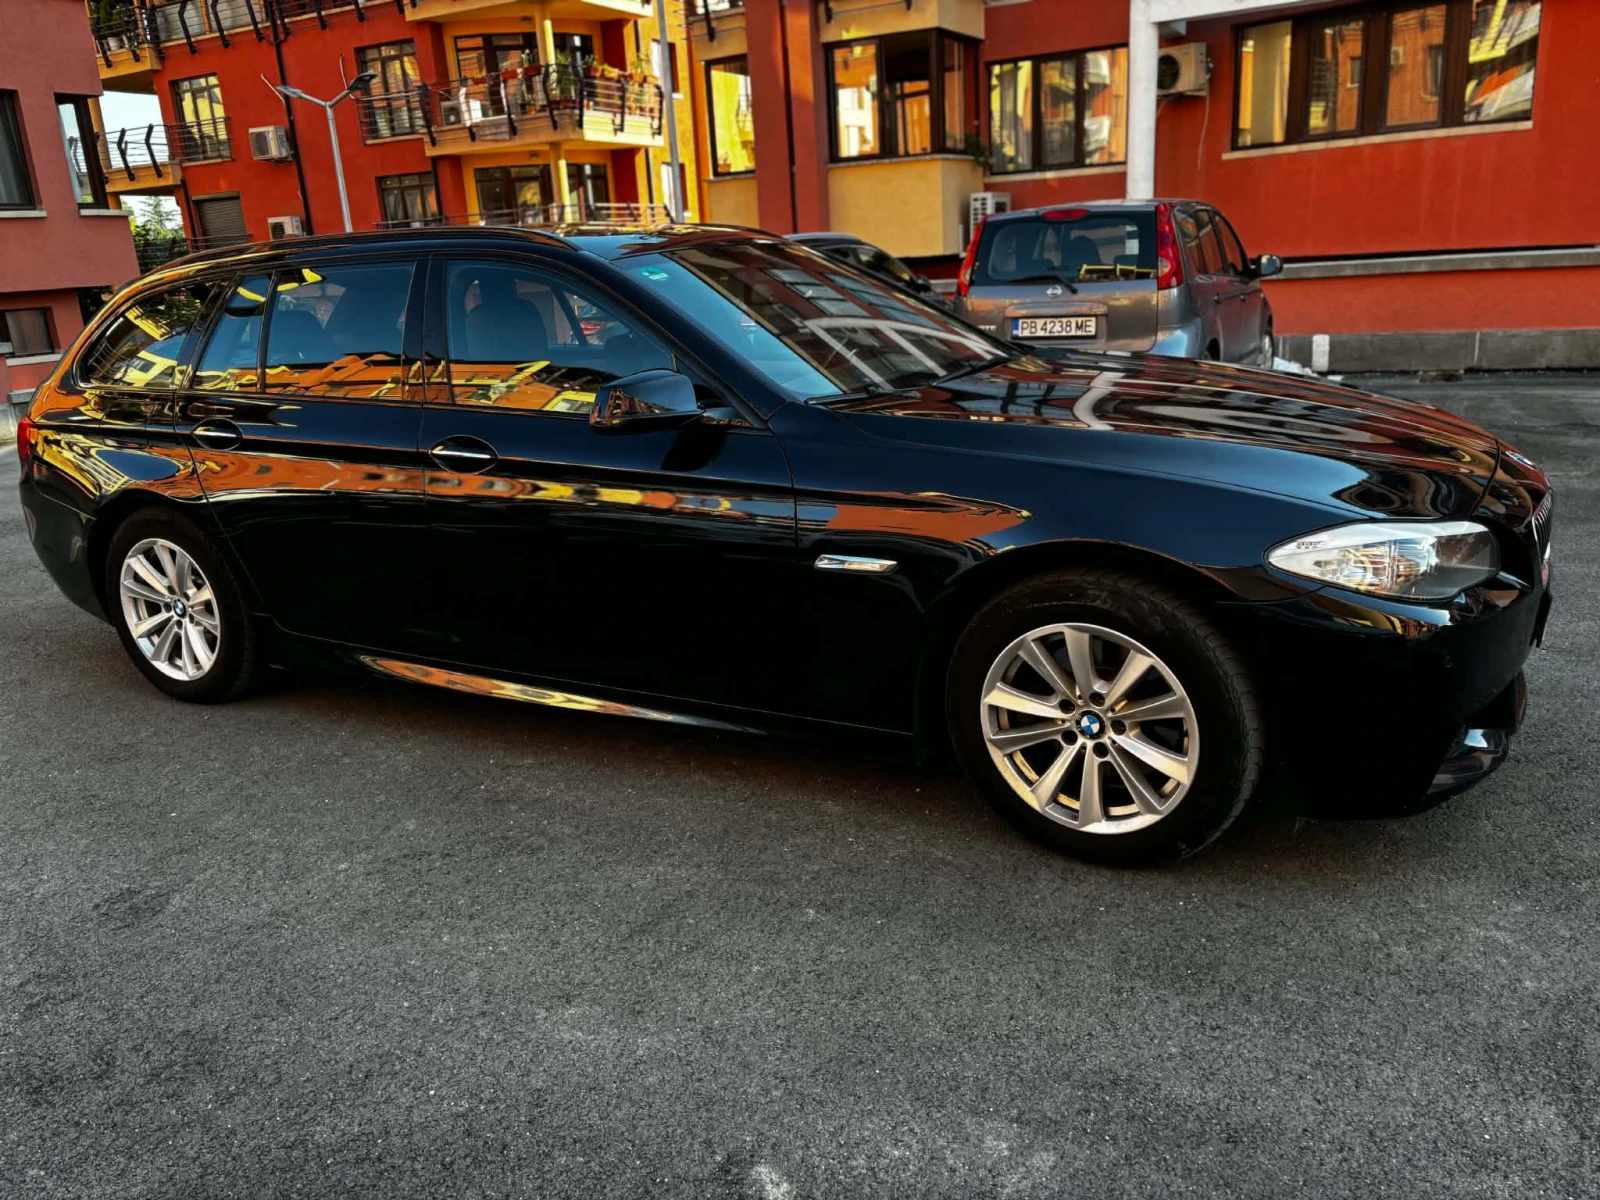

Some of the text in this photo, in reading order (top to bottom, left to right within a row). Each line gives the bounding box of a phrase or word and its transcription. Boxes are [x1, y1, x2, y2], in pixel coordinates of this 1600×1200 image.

[1020, 320, 1038, 335] PB
[1040, 319, 1073, 334] 4238
[1074, 319, 1094, 334] ME
